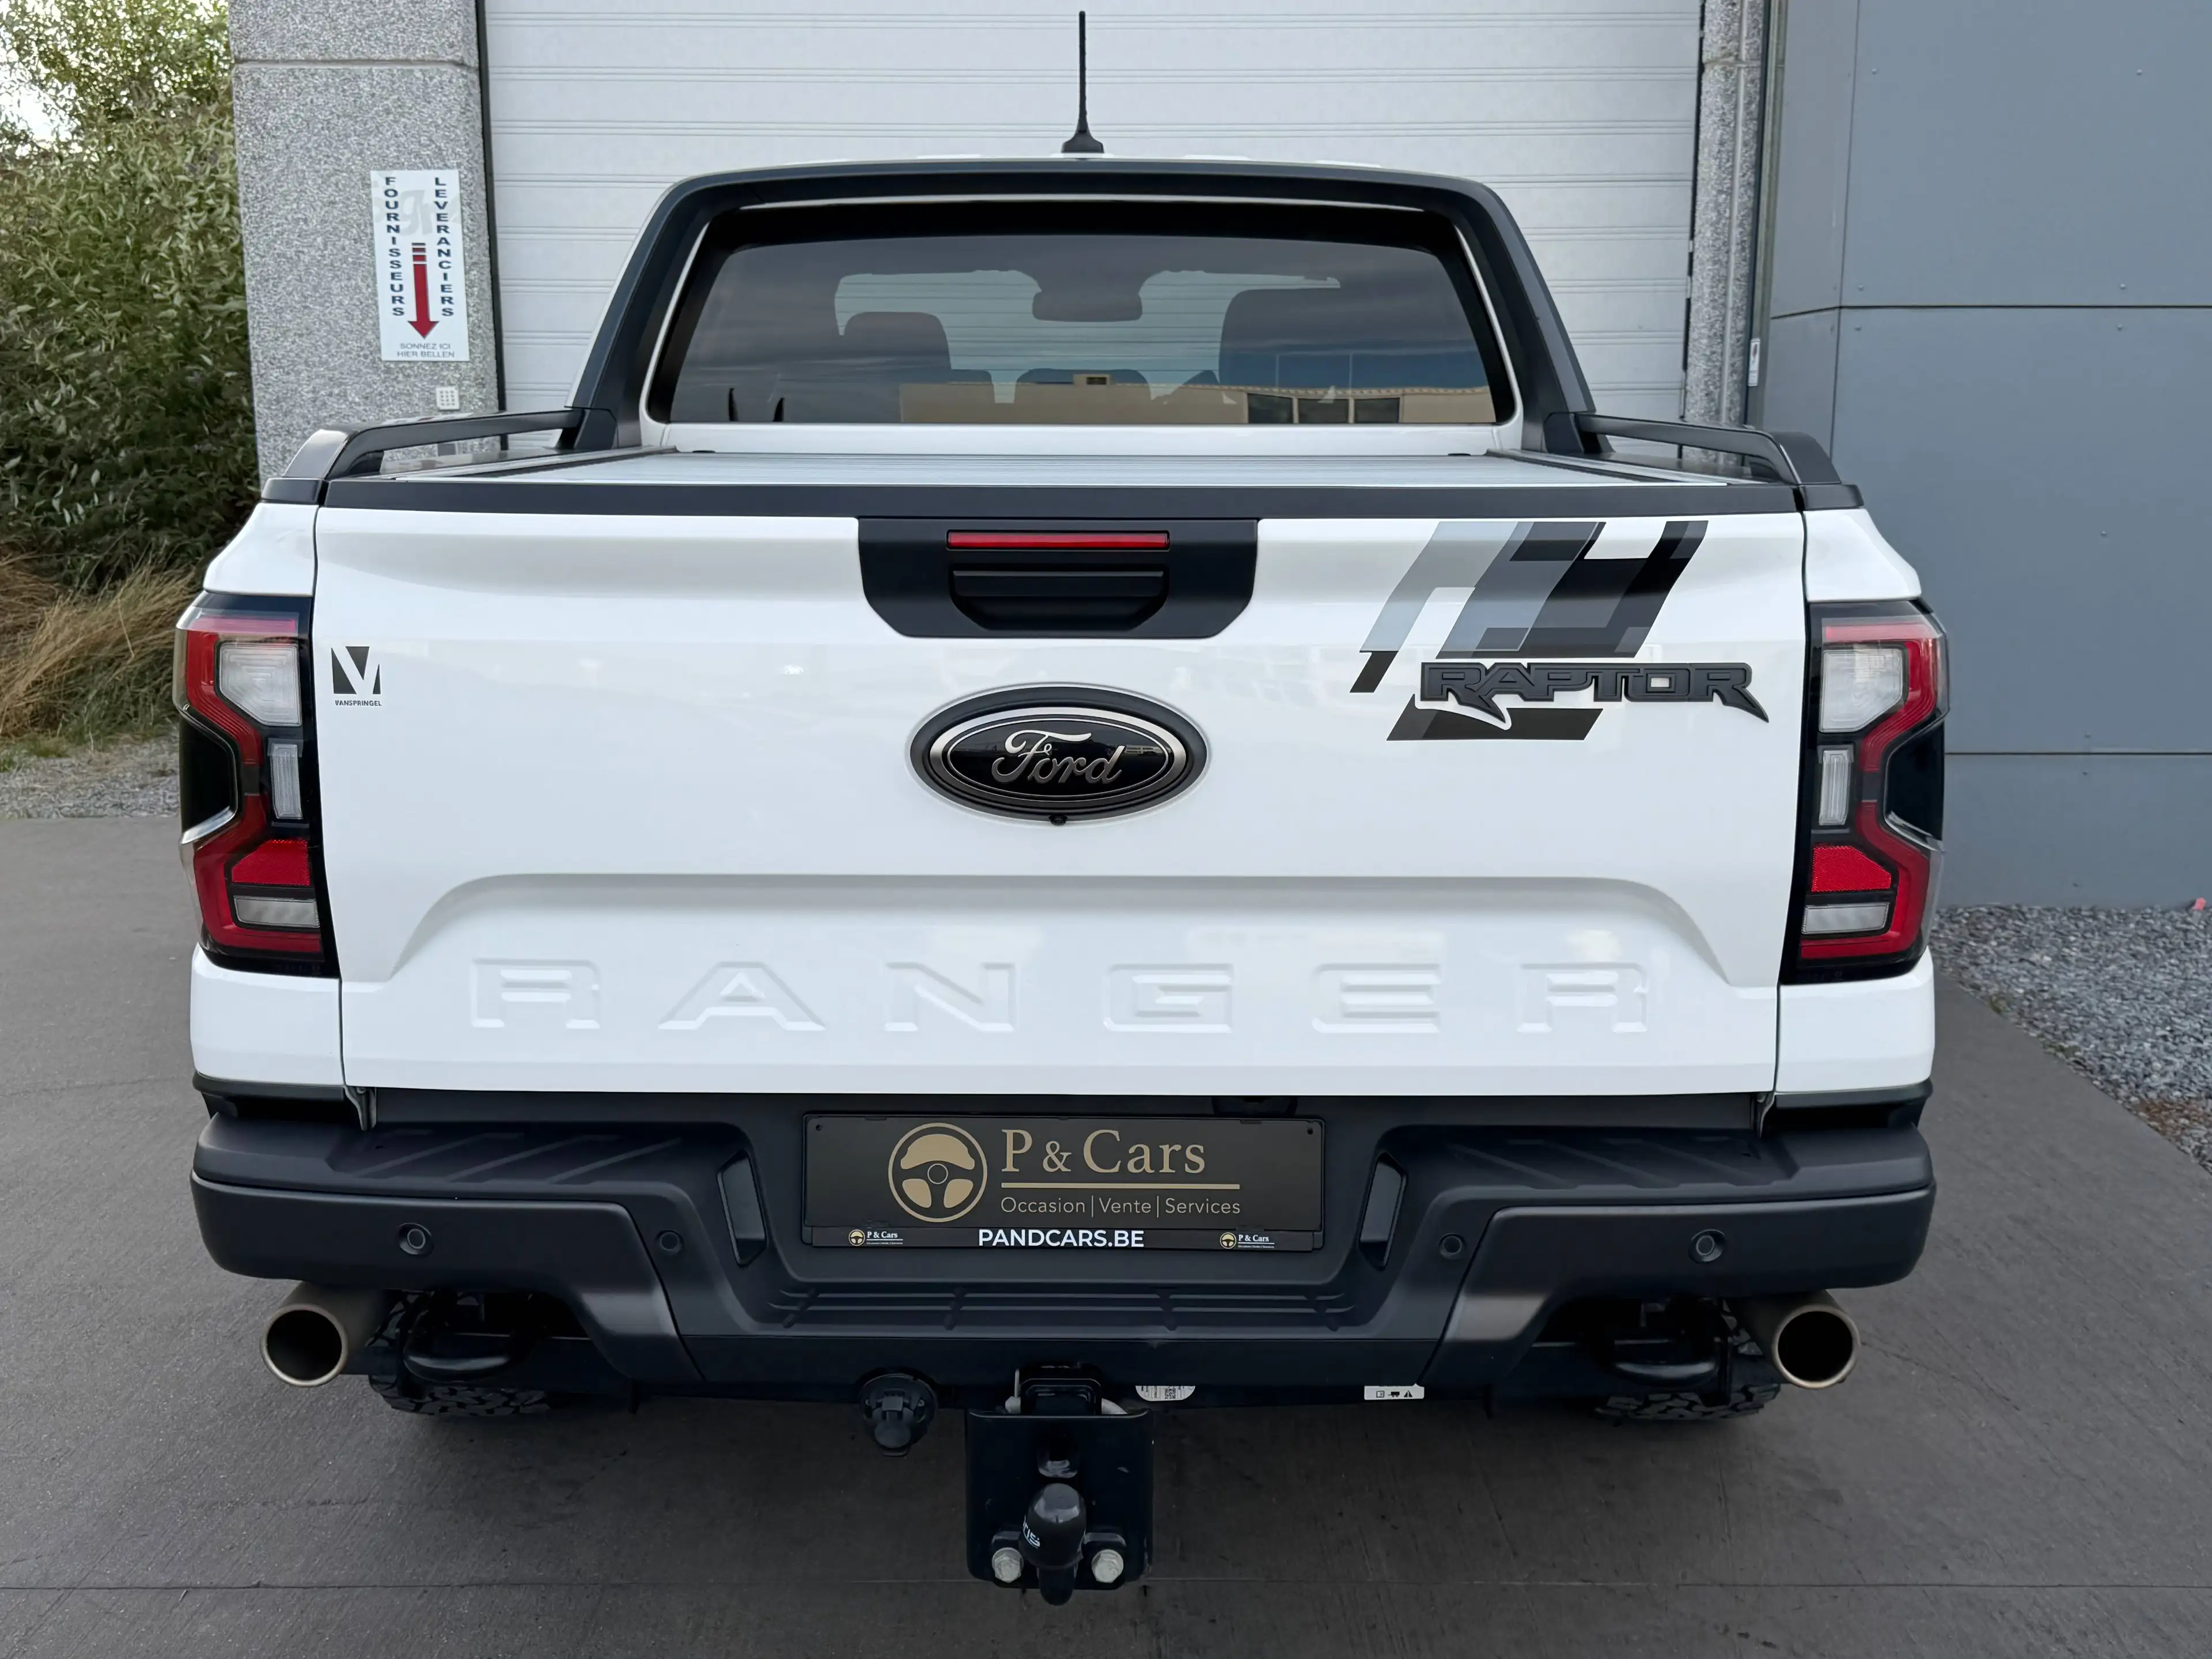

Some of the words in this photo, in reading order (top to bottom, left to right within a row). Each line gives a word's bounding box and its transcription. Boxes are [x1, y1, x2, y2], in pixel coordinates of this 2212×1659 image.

[384, 177, 405, 317] FOURNISSEURS
[433, 177, 454, 317] LEVERANCIERS
[1421, 662, 1769, 723] RAPTOR
[991, 729, 1126, 785] Ford
[469, 959, 1649, 1033] RANGER
[1001, 1129, 1033, 1173] P
[1042, 1141, 1072, 1173] &
[1083, 1129, 1206, 1174] Cars
[1001, 1196, 1086, 1214] Occasion
[1099, 1198, 1152, 1214] Vente
[1165, 1198, 1241, 1214] Services
[979, 1229, 1145, 1248] PANDCARS.BE
